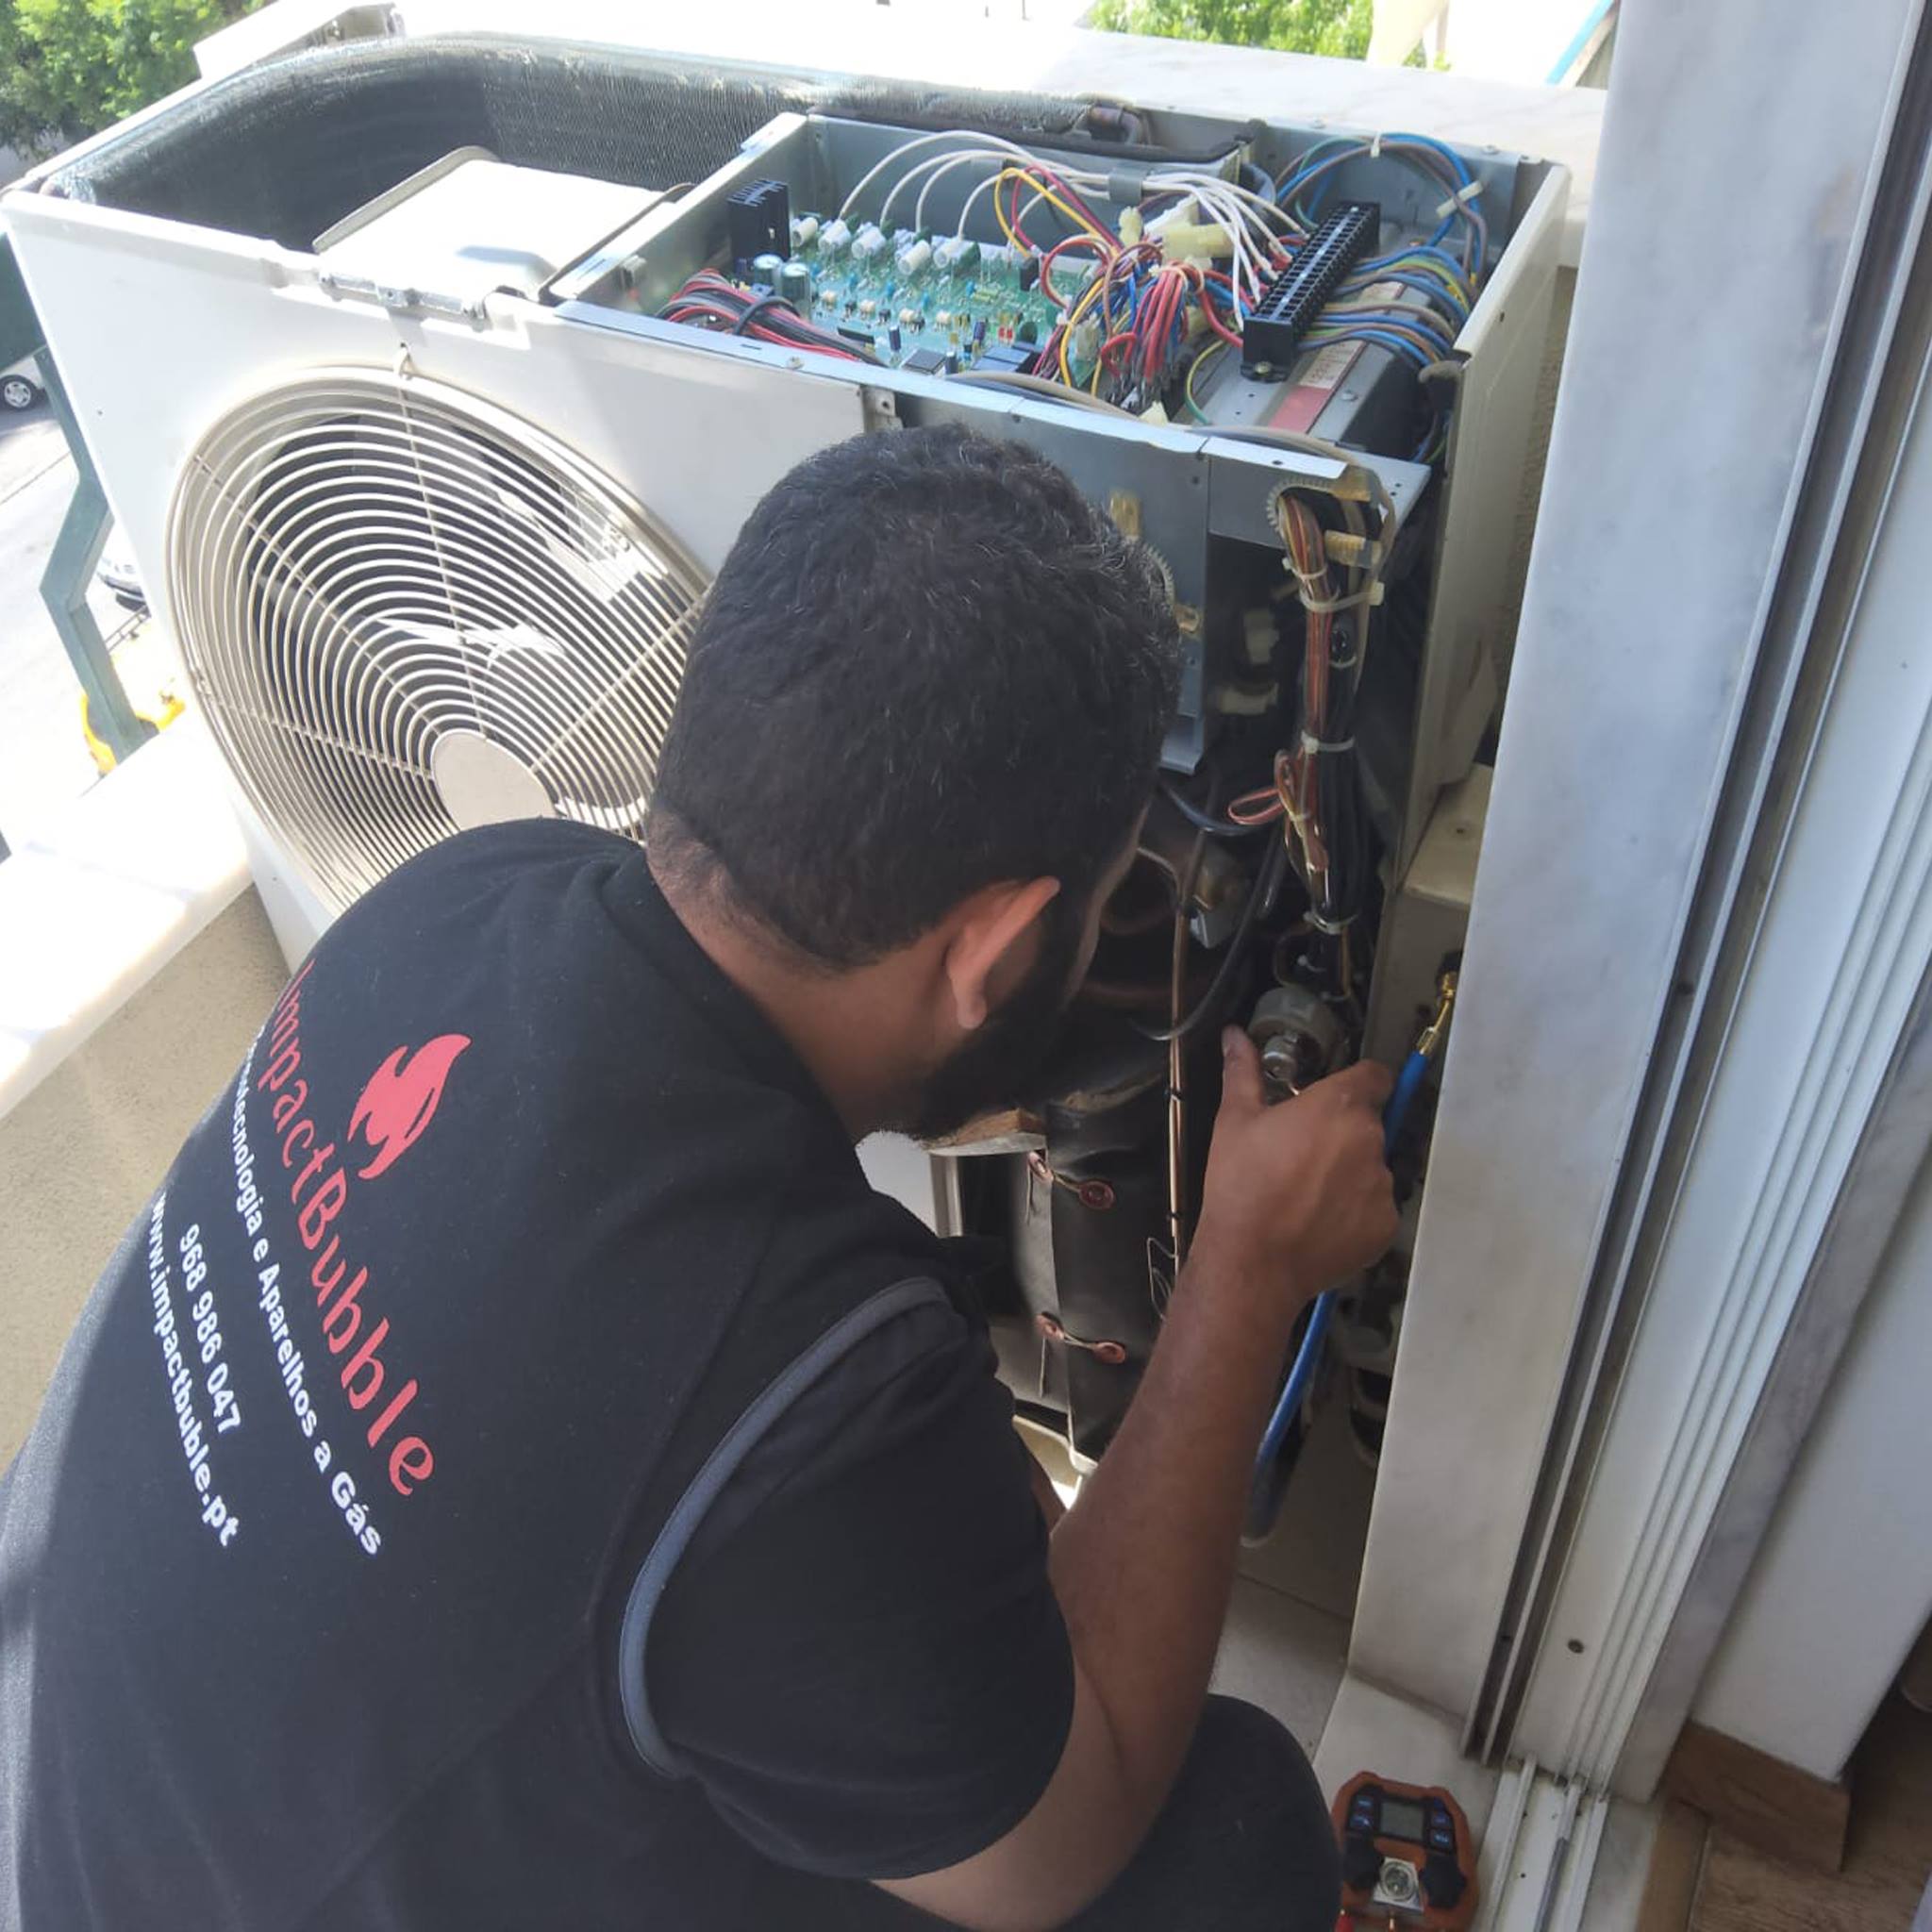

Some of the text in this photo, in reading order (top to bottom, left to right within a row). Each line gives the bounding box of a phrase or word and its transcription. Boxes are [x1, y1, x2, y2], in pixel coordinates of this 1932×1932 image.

[253, 1238, 269, 1263] e
[257, 958, 435, 1496] ImpactBubble
[149, 1191, 240, 1547] www.impactbuble.pt
[179, 1223, 242, 1434] 968 986 047
[258, 1262, 318, 1438] Aparelhos
[314, 1441, 331, 1474] a
[331, 1471, 381, 1555] Gás
